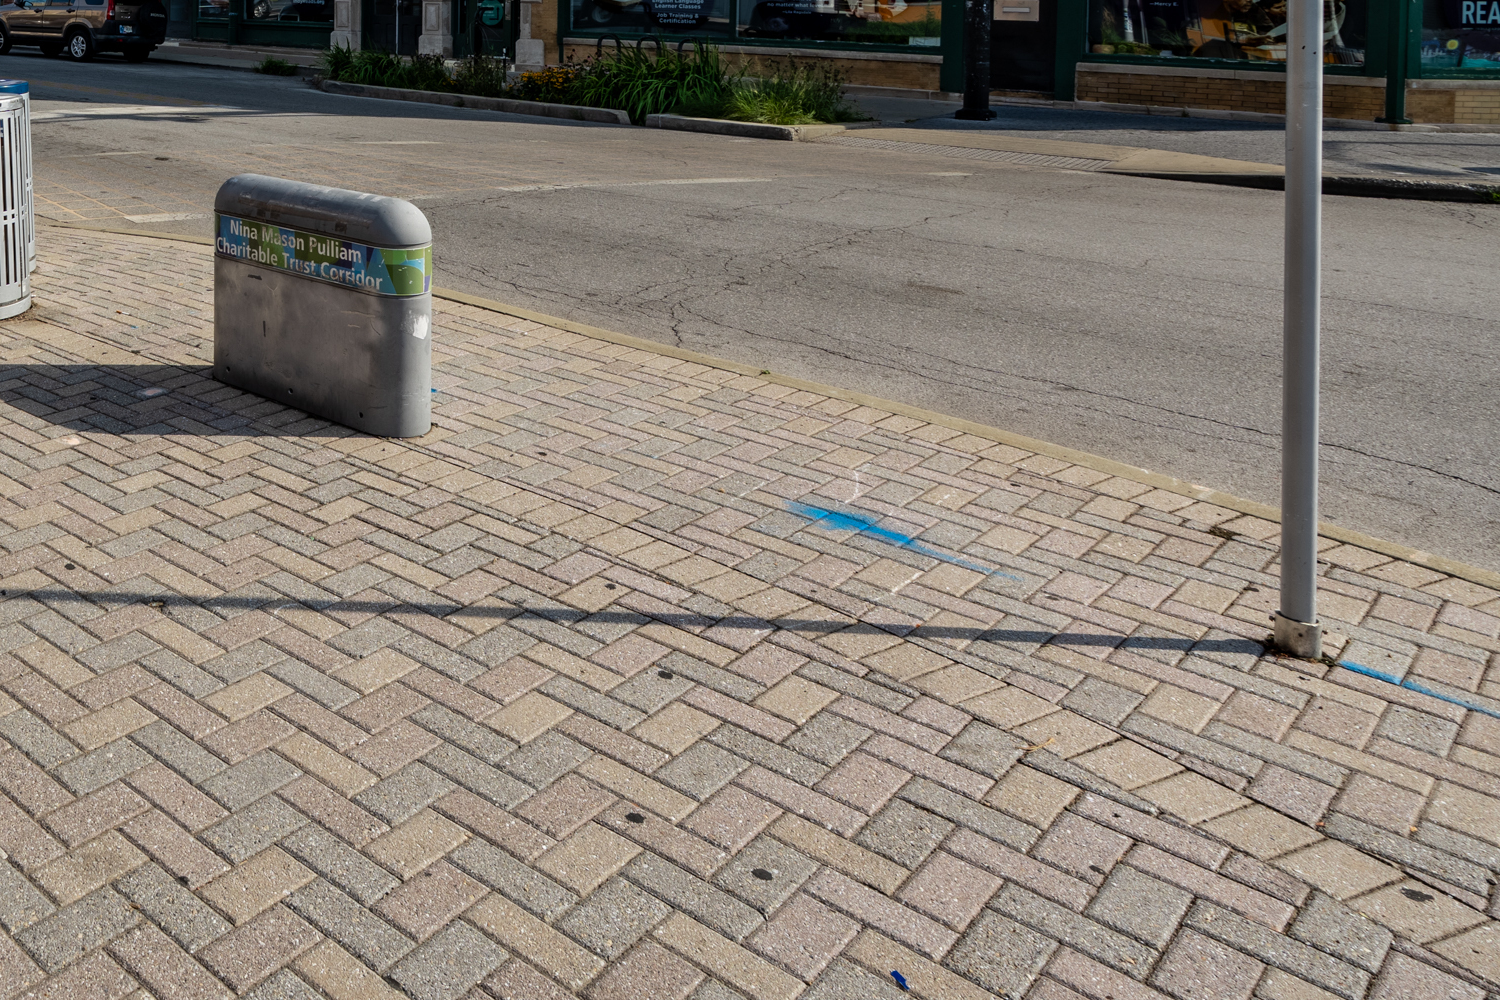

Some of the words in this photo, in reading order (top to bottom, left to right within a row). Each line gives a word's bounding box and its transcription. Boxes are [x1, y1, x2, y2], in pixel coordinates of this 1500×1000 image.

[216, 237, 278, 266] Charitable
[282, 252, 316, 276] Trust
[320, 263, 383, 290] Corridor
[230, 219, 258, 240] Nina
[261, 226, 304, 251] Mason
[309, 236, 362, 264] Pulliam
